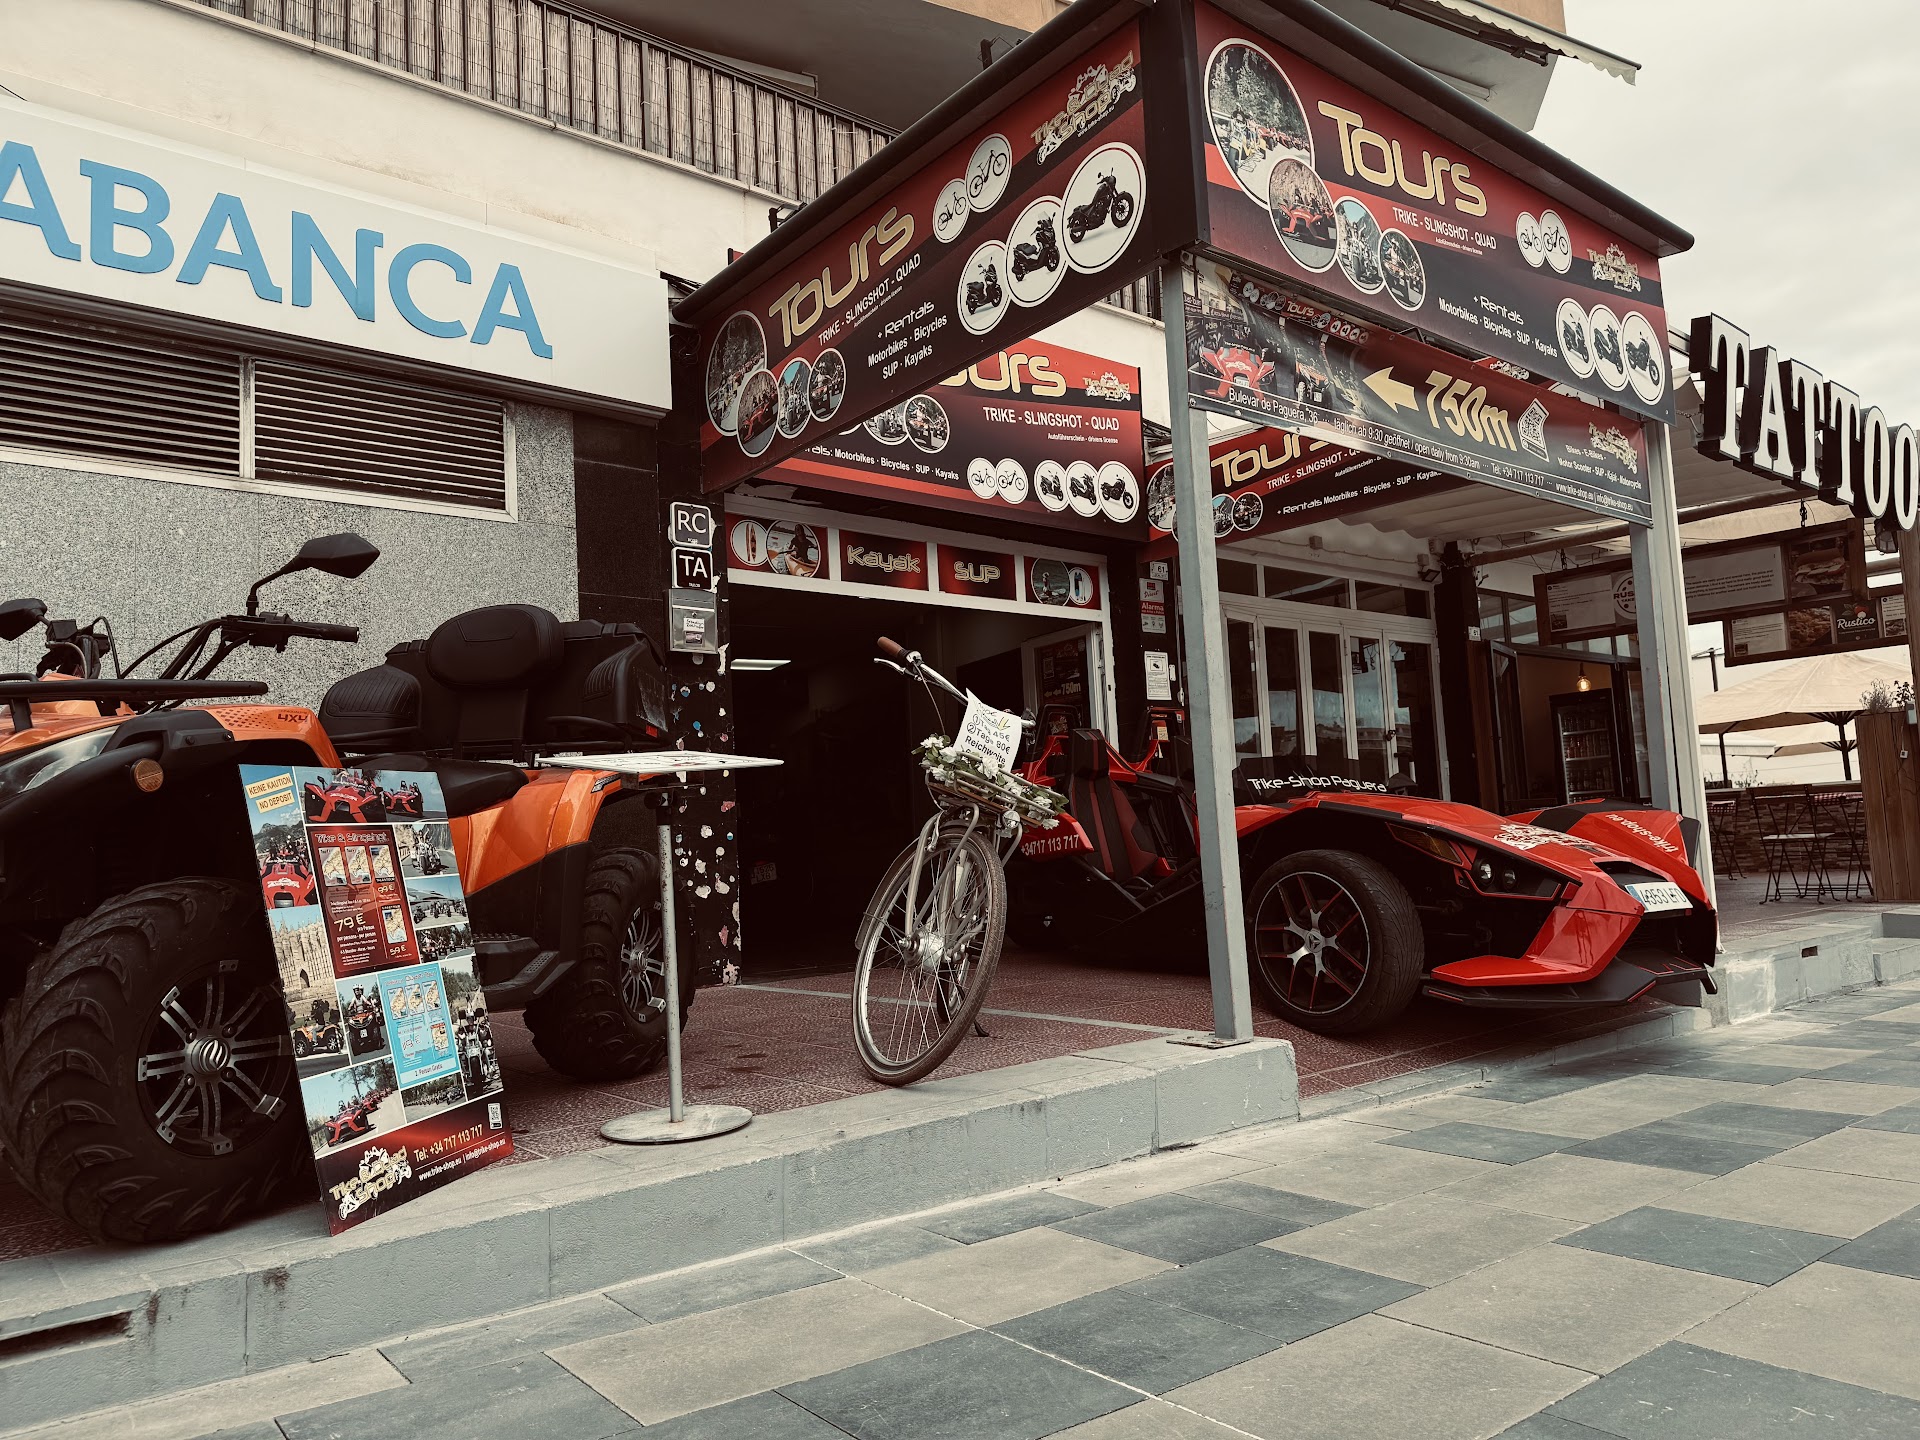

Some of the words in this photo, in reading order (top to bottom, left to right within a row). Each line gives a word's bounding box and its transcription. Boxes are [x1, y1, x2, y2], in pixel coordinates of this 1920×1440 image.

[1392, 206, 1419, 228] TRIKE
[1424, 216, 1469, 243] SLINGSHOT
[1474, 232, 1497, 250] QUAD
[0, 140, 553, 360] ABANCA
[818, 318, 841, 346] TRIKE
[845, 277, 890, 323] SLINGSHOT
[895, 252, 921, 283] QUAD
[1480, 295, 1524, 326] Rentals
[884, 301, 935, 338] Rentals
[1438, 297, 1479, 325] Motorbikes
[1483, 315, 1512, 340] Bicycles
[1516, 328, 1531, 346] SUP
[1534, 337, 1558, 358] Kayaks
[868, 337, 908, 368] Motorbikes
[914, 314, 948, 342] Bicycles
[882, 360, 899, 380] SUP
[904, 343, 933, 368] Kayaks
[983, 406, 1016, 424] TRIKE
[1024, 410, 1083, 429] SLINGSHOT
[1091, 417, 1120, 431] QUAD
[1425, 370, 1518, 452] 750m
[1710, 312, 1919, 532] TATTOO
[1228, 387, 1259, 408] Bulevar
[1261, 398, 1272, 411] de
[1334, 417, 1357, 435] täglich
[1358, 427, 1368, 438] ab
[1368, 427, 1384, 442] 9:30
[1384, 432, 1411, 450] geöffnet
[1415, 441, 1430, 458] open
[1431, 445, 1445, 462] daily
[1445, 450, 1459, 464] from
[1459, 455, 1481, 470] 9:30am
[1502, 466, 1513, 479] +34
[1513, 469, 1524, 481] 717
[1524, 472, 1534, 483] 113
[1534, 475, 1545, 487] 717
[834, 448, 875, 465] Motorbikes
[880, 457, 910, 471] Bicycles
[915, 464, 930, 475] SUP
[934, 467, 960, 481] Kayaks
[1266, 474, 1290, 491] TRIKE
[1296, 454, 1343, 479] SLINGSHOT
[1594, 466, 1604, 477] SUP
[1283, 498, 1323, 515] Rentals
[1323, 489, 1358, 505] Motorbikes
[1363, 481, 1391, 495] Bicycles
[1396, 474, 1411, 486] SUP
[677, 509, 707, 534] RC
[679, 554, 708, 579] TA
[847, 544, 921, 573] Kayak
[1141, 602, 1165, 611] Alarma
[1836, 616, 1876, 630] Rustico
[1061, 681, 1082, 695] 750m
[248, 783, 267, 795] KEINE
[267, 776, 291, 791] KAUTION
[1247, 775, 1331, 790] Trike-Shop
[1331, 775, 1388, 792] Paguera
[259, 800, 269, 810] NO
[268, 792, 292, 807] DEPOSIT
[1047, 837, 1061, 852] 113
[1063, 834, 1080, 850] 717
[1605, 813, 1679, 853] trike-shop.eu
[1639, 888, 1669, 906] 4353
[334, 916, 355, 932] 79
[355, 912, 366, 925] €
[413, 1147, 429, 1163] Tel:
[429, 1139, 444, 1155] +34
[443, 1134, 457, 1151] 717
[457, 1129, 471, 1145] 113
[470, 1123, 483, 1139] 717
[418, 1157, 462, 1181] www.trike-shop.eu
[465, 1138, 506, 1161] info@trike-shop.eu
